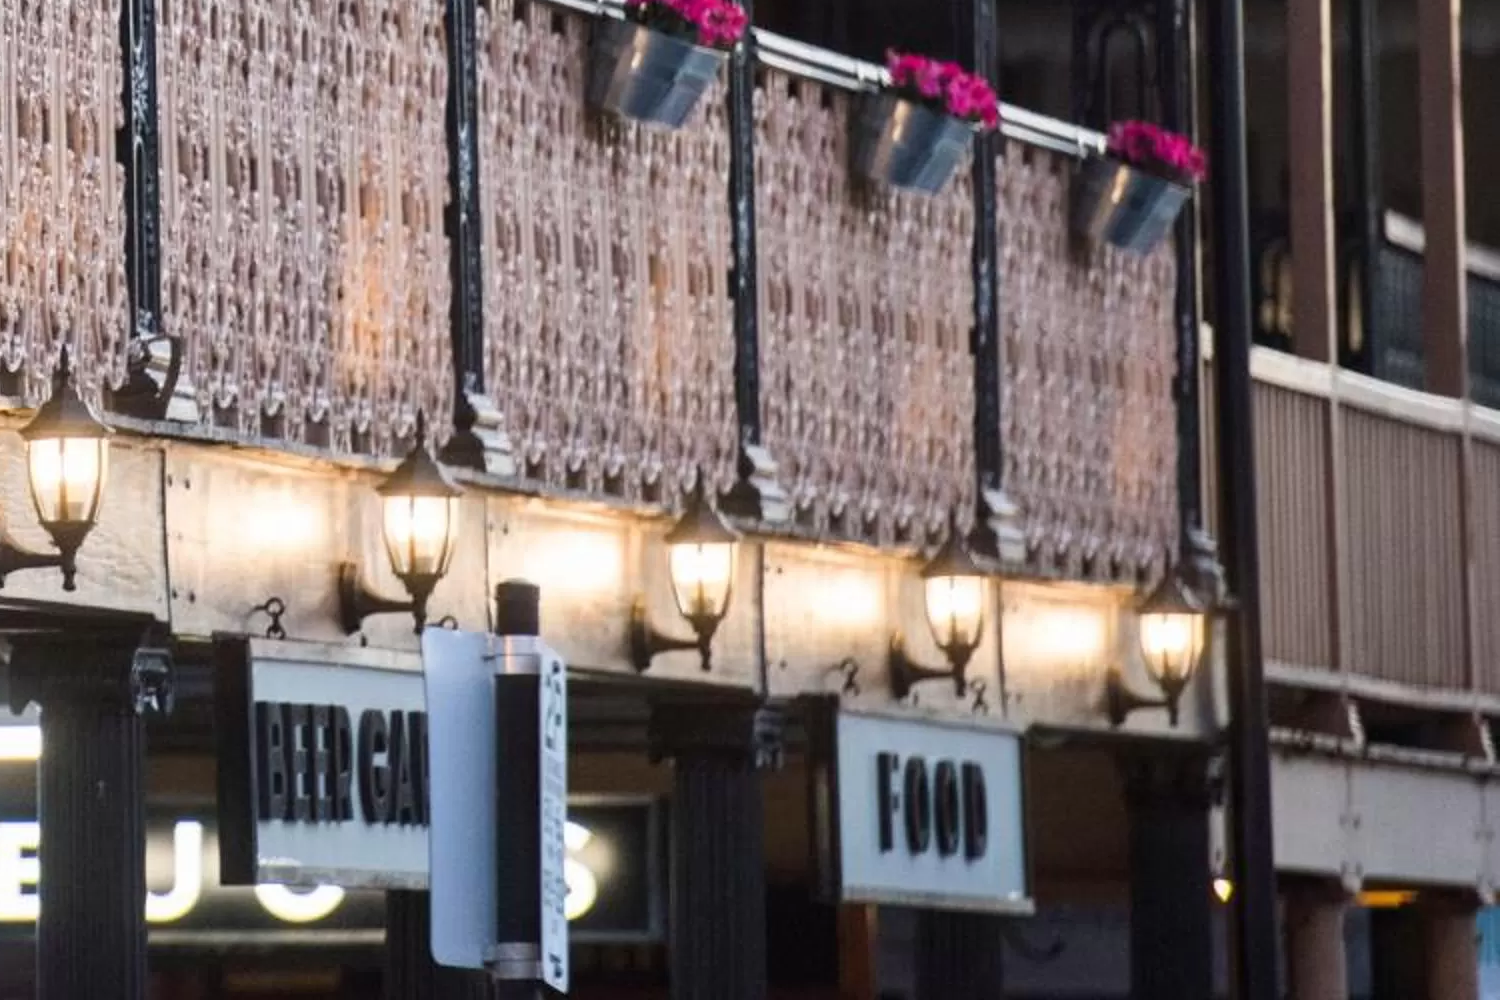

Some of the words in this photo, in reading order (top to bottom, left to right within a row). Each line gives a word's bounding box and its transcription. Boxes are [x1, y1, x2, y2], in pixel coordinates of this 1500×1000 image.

[256, 701, 354, 824] BEER
[357, 708, 430, 827] GA
[876, 751, 989, 865] FOOD
